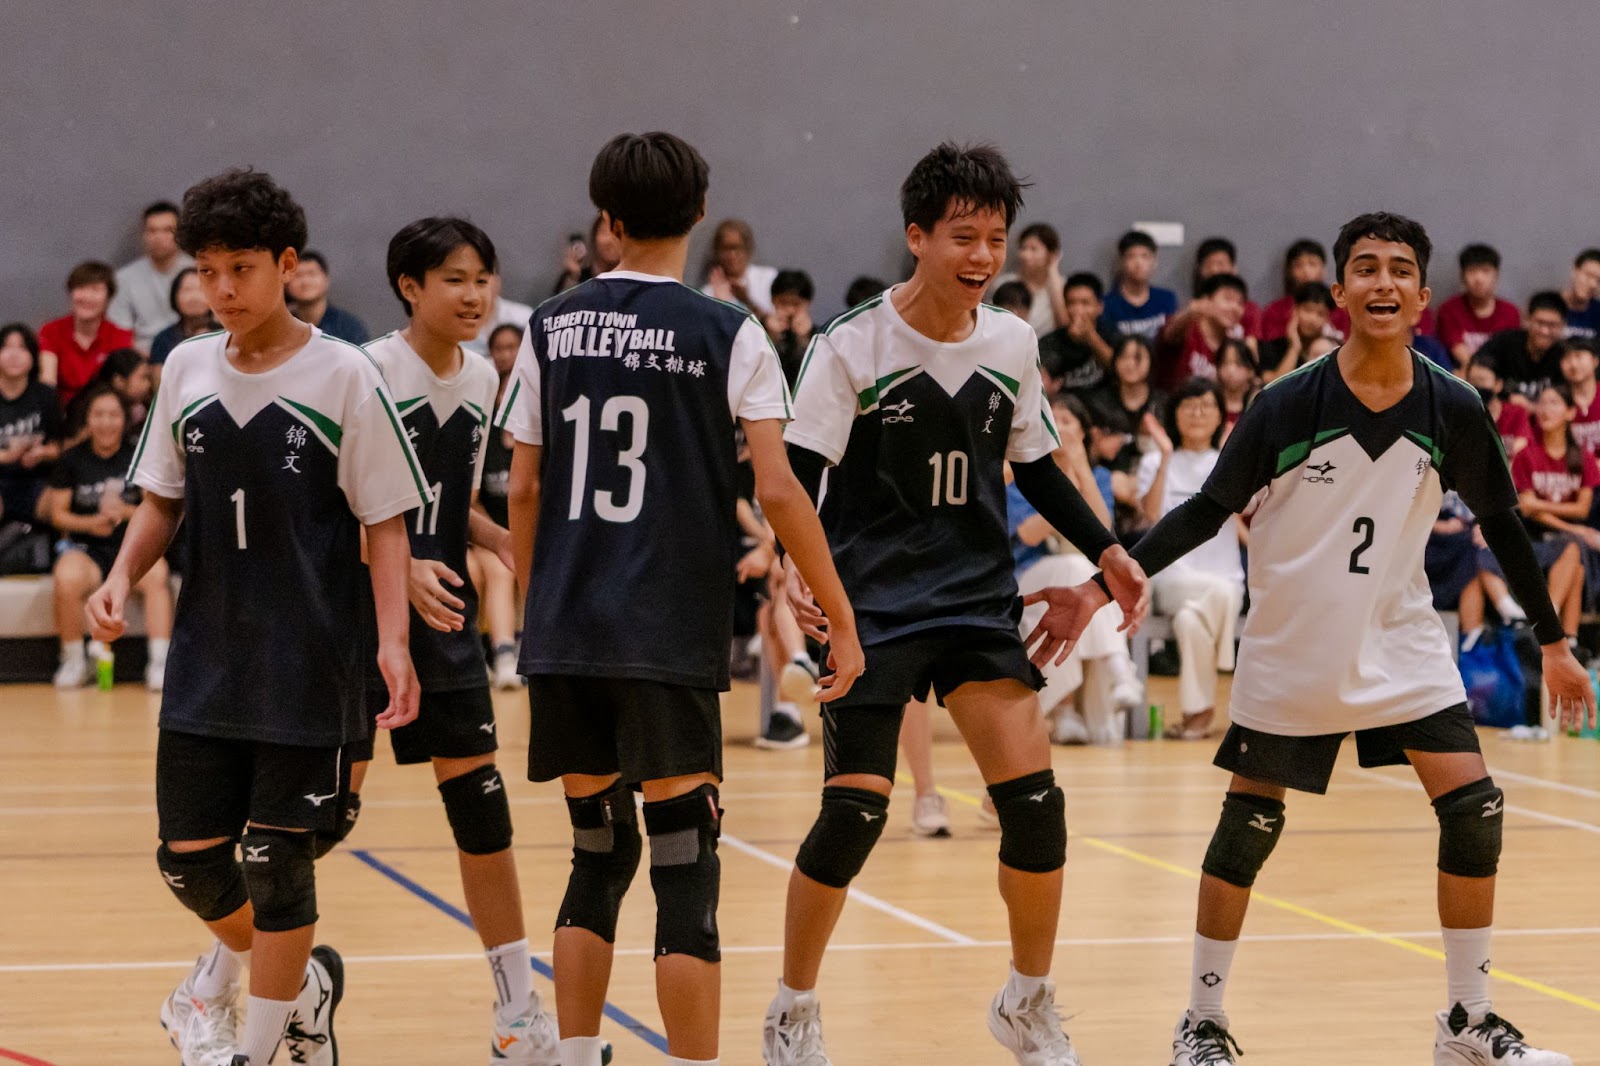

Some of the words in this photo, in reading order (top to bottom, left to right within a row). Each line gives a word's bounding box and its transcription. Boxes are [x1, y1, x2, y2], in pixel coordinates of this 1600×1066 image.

[547, 325, 675, 362] VOLLEYBALL
[598, 311, 638, 329] TOWN
[622, 352, 708, 378] 锦文排球
[982, 391, 1001, 434] 锦文
[282, 424, 308, 474] 锦文
[561, 393, 650, 523] 13
[928, 450, 968, 507] 10
[230, 487, 248, 550] 1
[1348, 516, 1375, 575] 2
